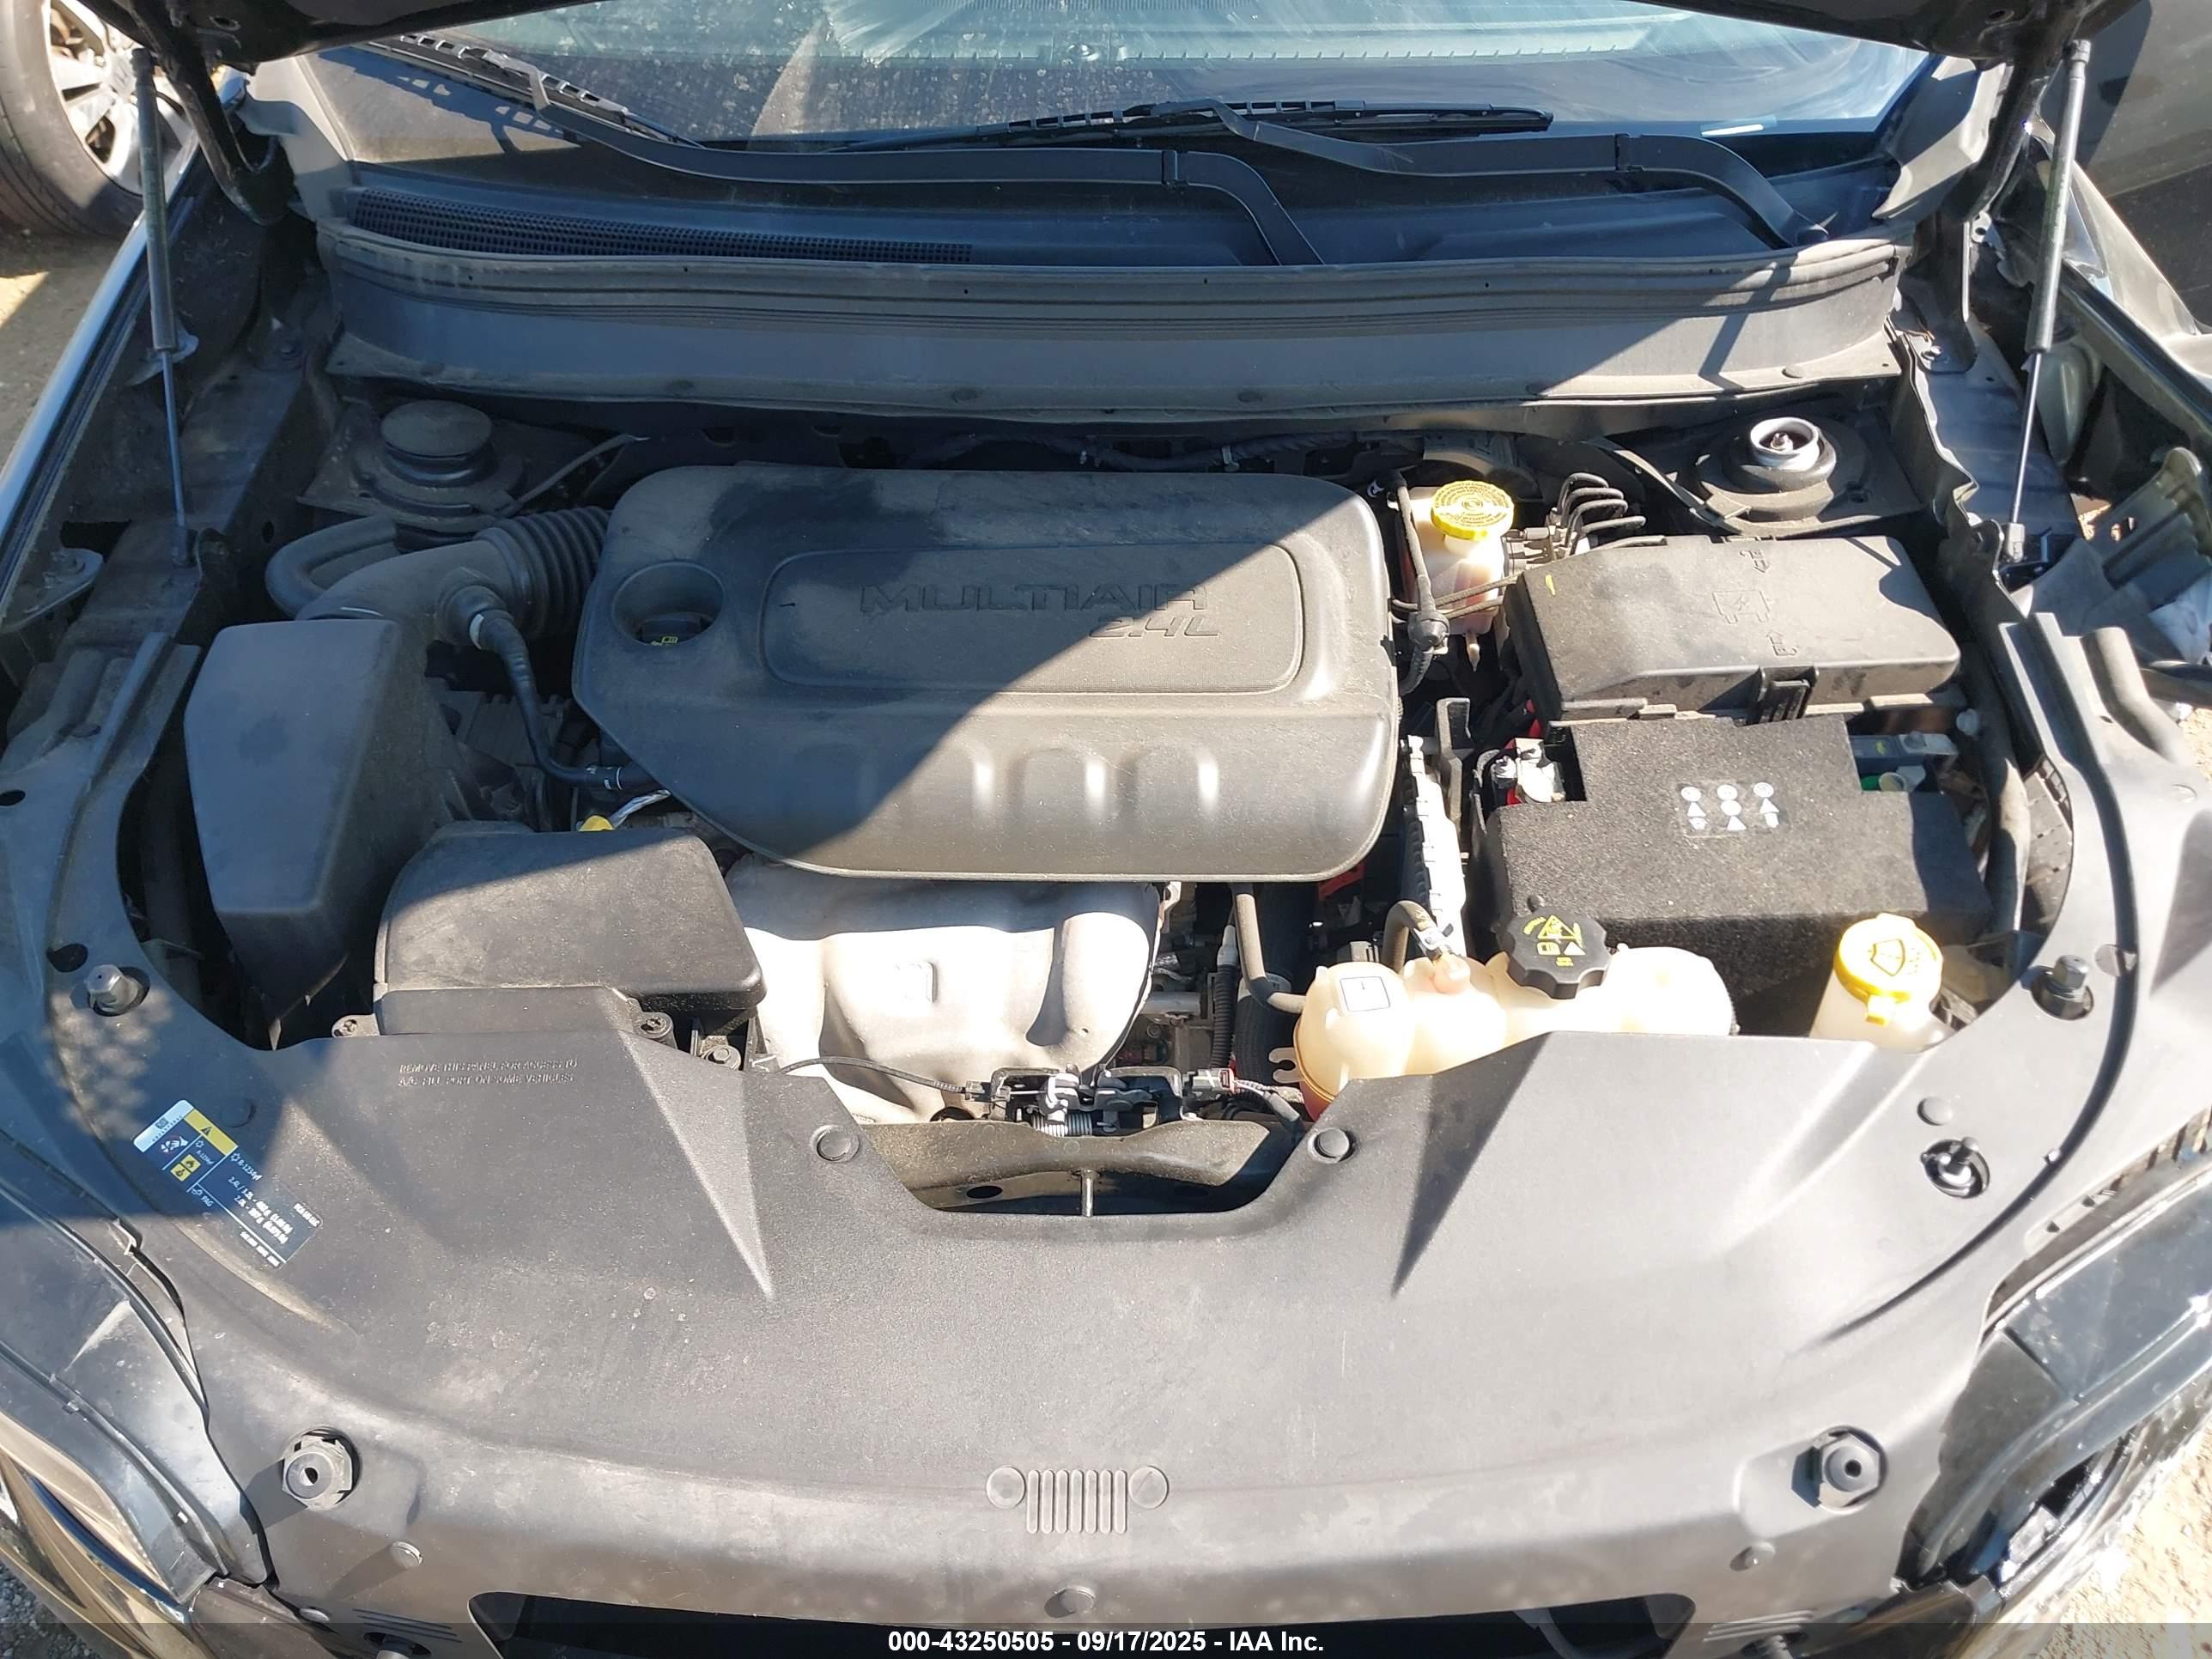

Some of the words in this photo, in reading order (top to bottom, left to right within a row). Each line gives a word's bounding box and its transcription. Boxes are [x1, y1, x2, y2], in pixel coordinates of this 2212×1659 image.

[860, 583, 1208, 613] MULTIAIR
[1088, 615, 1219, 639] 2.4L
[399, 1063, 441, 1073] REMOVE
[443, 1062, 465, 1073] THIS
[466, 1060, 499, 1073] PANEL
[501, 1060, 520, 1071] FOR
[565, 1058, 578, 1069] TO
[422, 1075, 441, 1086] FILL
[446, 1074, 472, 1085] PORT
[475, 1074, 490, 1085] ON
[492, 1073, 521, 1085] SOME
